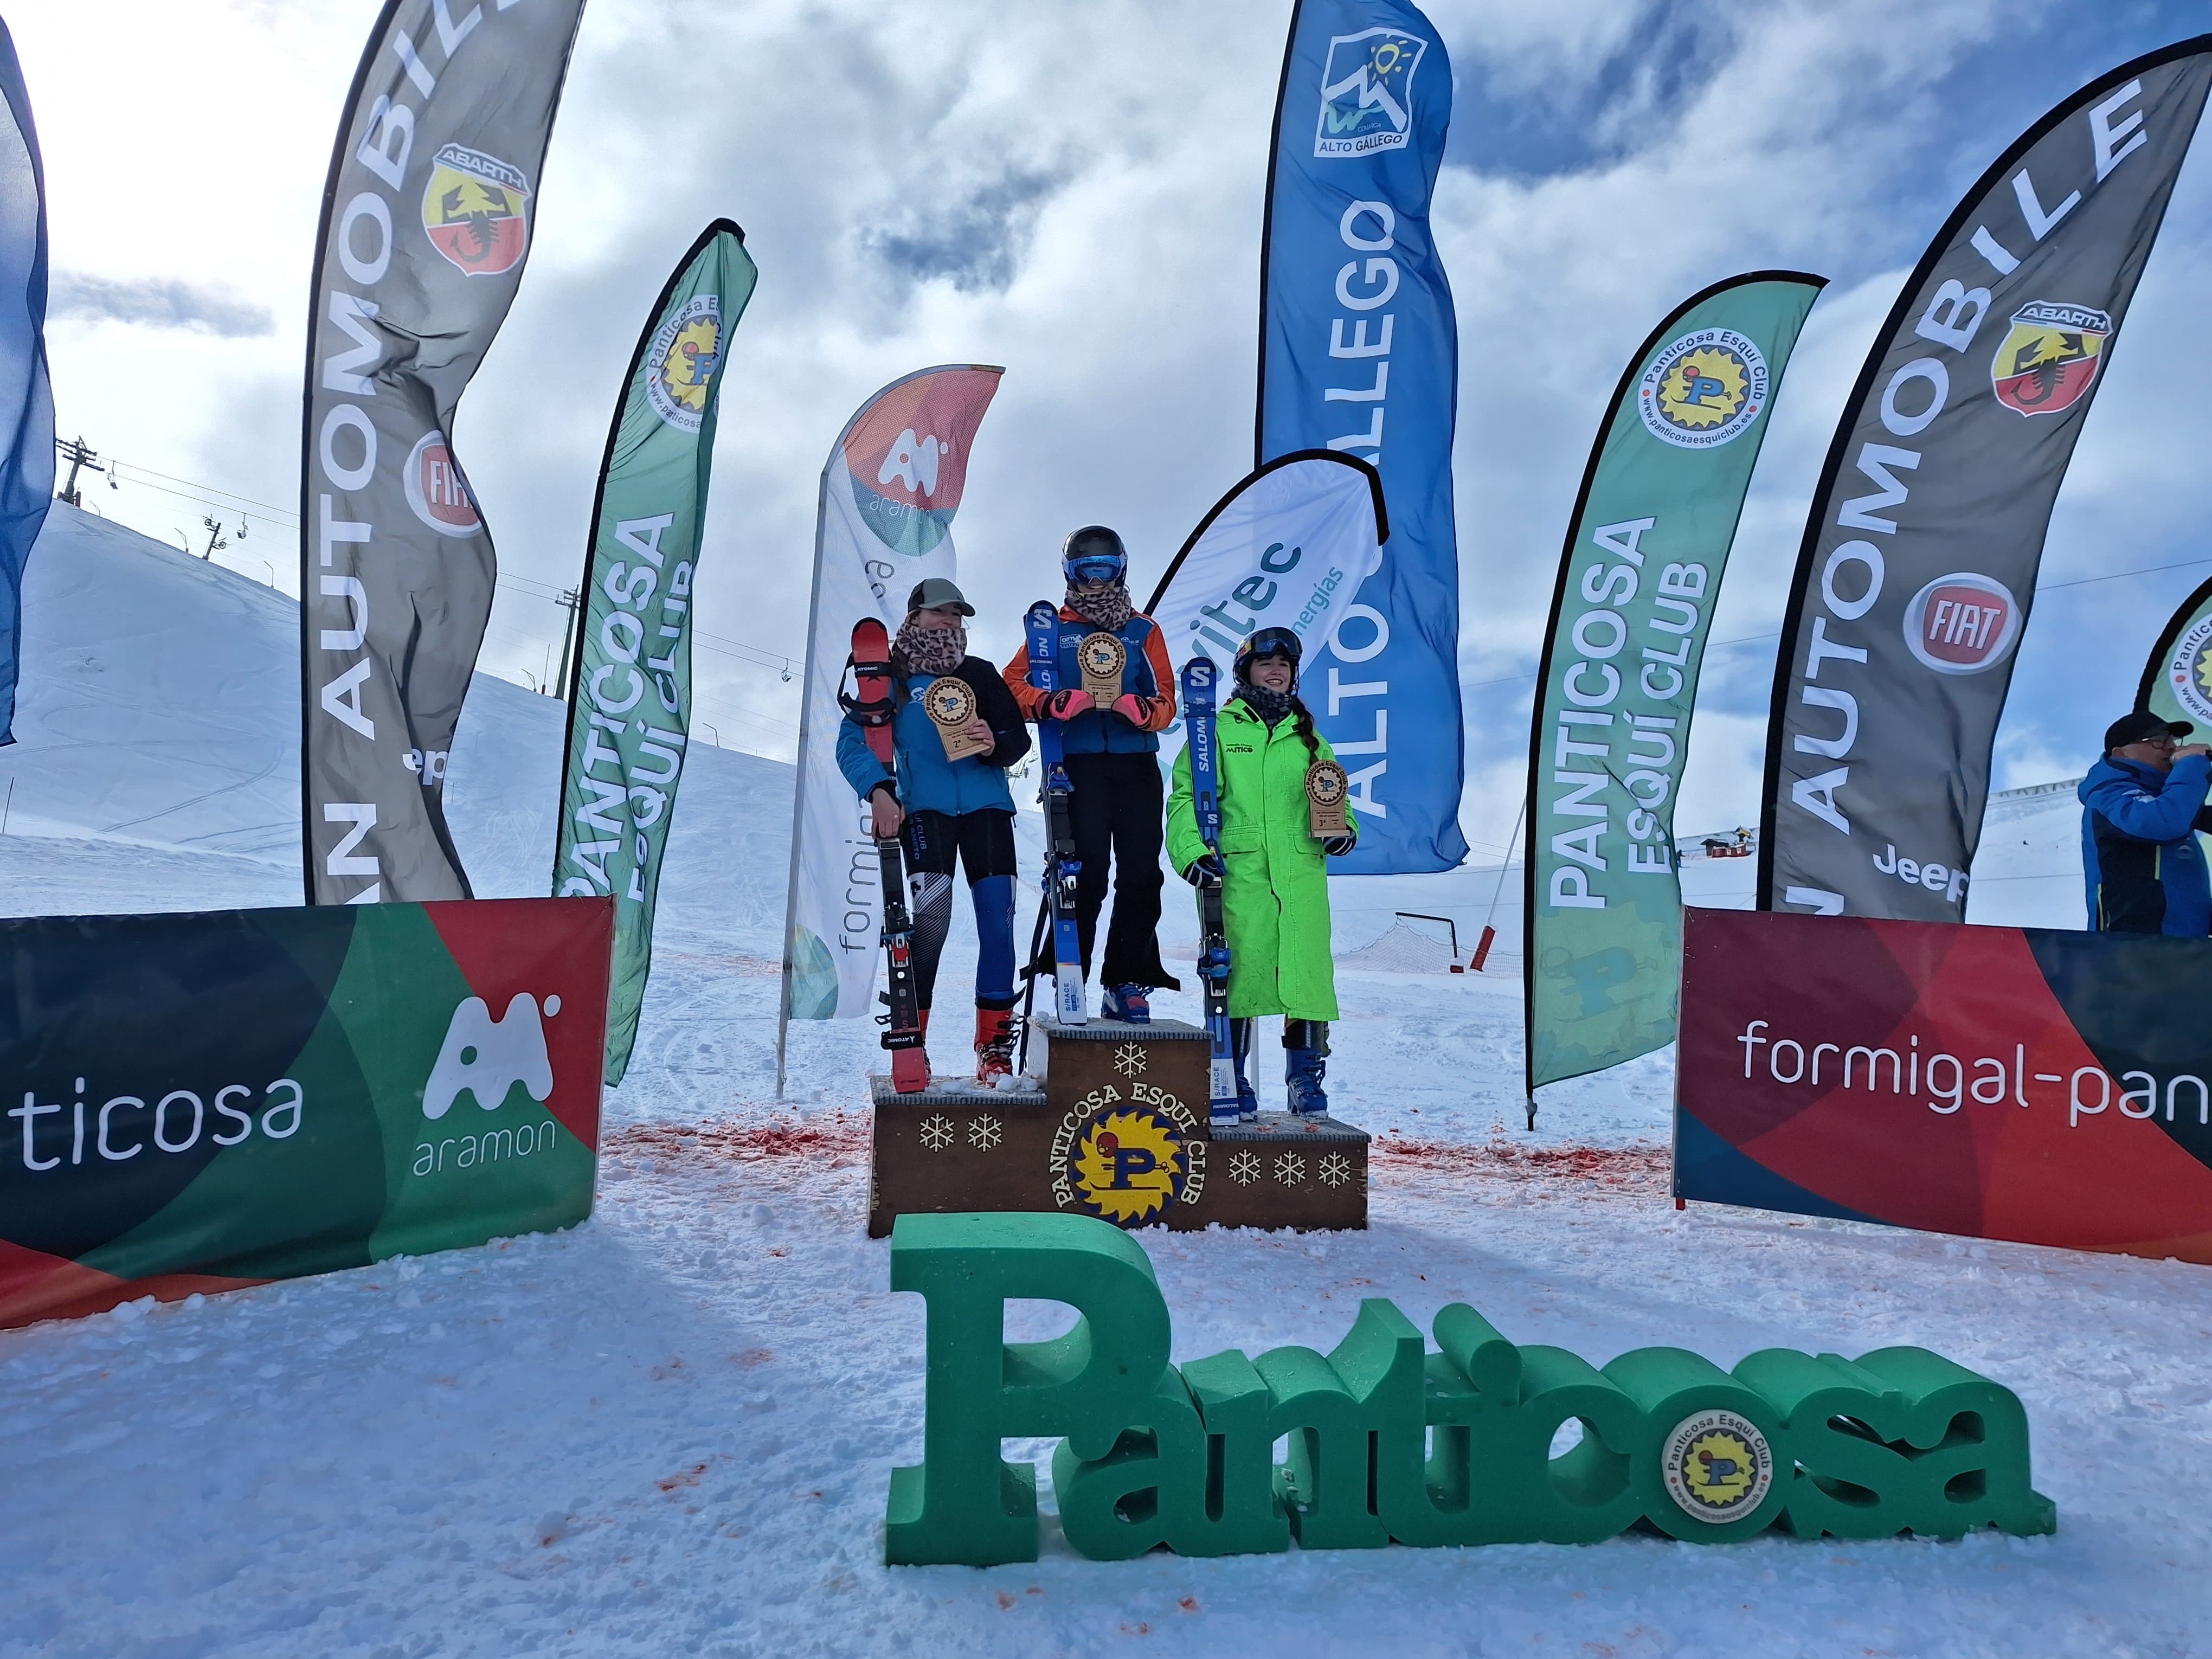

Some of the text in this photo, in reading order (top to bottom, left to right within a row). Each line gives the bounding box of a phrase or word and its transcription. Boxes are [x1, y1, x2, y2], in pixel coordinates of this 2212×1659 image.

[442, 149, 523, 188] ABARTH
[1319, 134, 1403, 152] ALTO GÁLLEGO
[649, 300, 703, 369] Panticosa
[2023, 305, 2107, 330] ABARTH
[320, 0, 522, 741] AUTOMOBIL
[1644, 331, 1767, 400] Panticosa Esquí Club
[1791, 79, 2147, 835] AUTOMOBILE
[1291, 567, 1344, 636] nergías
[1928, 600, 2002, 650] FIAT
[2174, 620, 2212, 670] Pantic
[1549, 515, 1657, 909] PANTICOSA
[1623, 561, 1709, 874] ESQUÍ CLUB
[917, 824, 927, 850] CLUB
[1737, 1020, 2208, 1127] formigal-pan
[7, 1076, 304, 1171] ticosa
[412, 1120, 556, 1176] aramon
[1049, 1084, 1122, 1208] PANTICOSA
[1130, 1082, 1198, 1134] ESQUI
[1180, 1140, 1206, 1205] CLUB
[886, 1212, 2057, 1566] Panticosa
[1668, 1414, 1771, 1471] Panticosa Esquí Club
